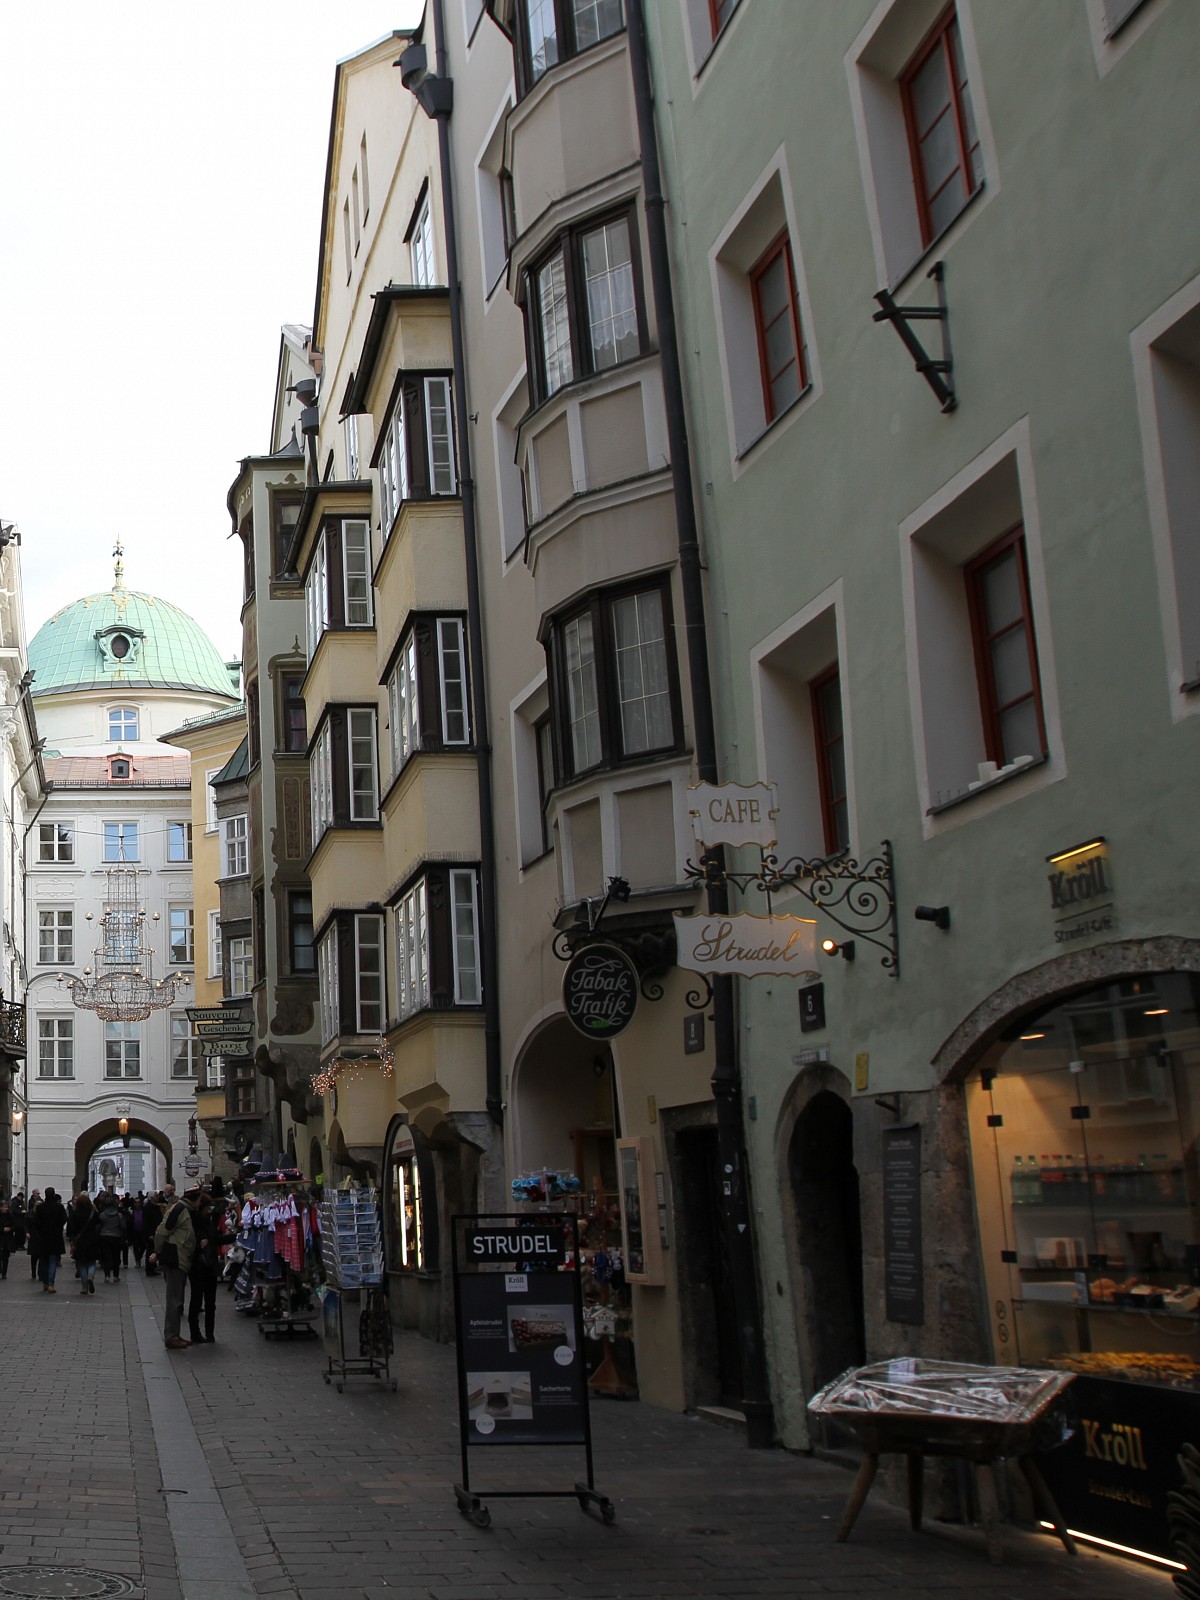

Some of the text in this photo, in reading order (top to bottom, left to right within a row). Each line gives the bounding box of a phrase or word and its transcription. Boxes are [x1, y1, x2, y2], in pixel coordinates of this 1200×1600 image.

[708, 798, 761, 823] CAFE
[1048, 856, 1108, 909] Kröll
[693, 921, 800, 962] Strudel
[570, 961, 632, 993] Tabak
[570, 992, 631, 1018] Trafik
[807, 994, 814, 1012] 6
[193, 1010, 236, 1019] Souvenir
[203, 1024, 247, 1032] Geschenke
[690, 1022, 695, 1038] 8
[211, 1042, 242, 1050] Burg
[472, 1234, 558, 1255] STRUDEL
[508, 1276, 525, 1284] Kröll
[469, 1319, 503, 1327] Apfelstrudel
[1081, 1418, 1150, 1472] Kröll
